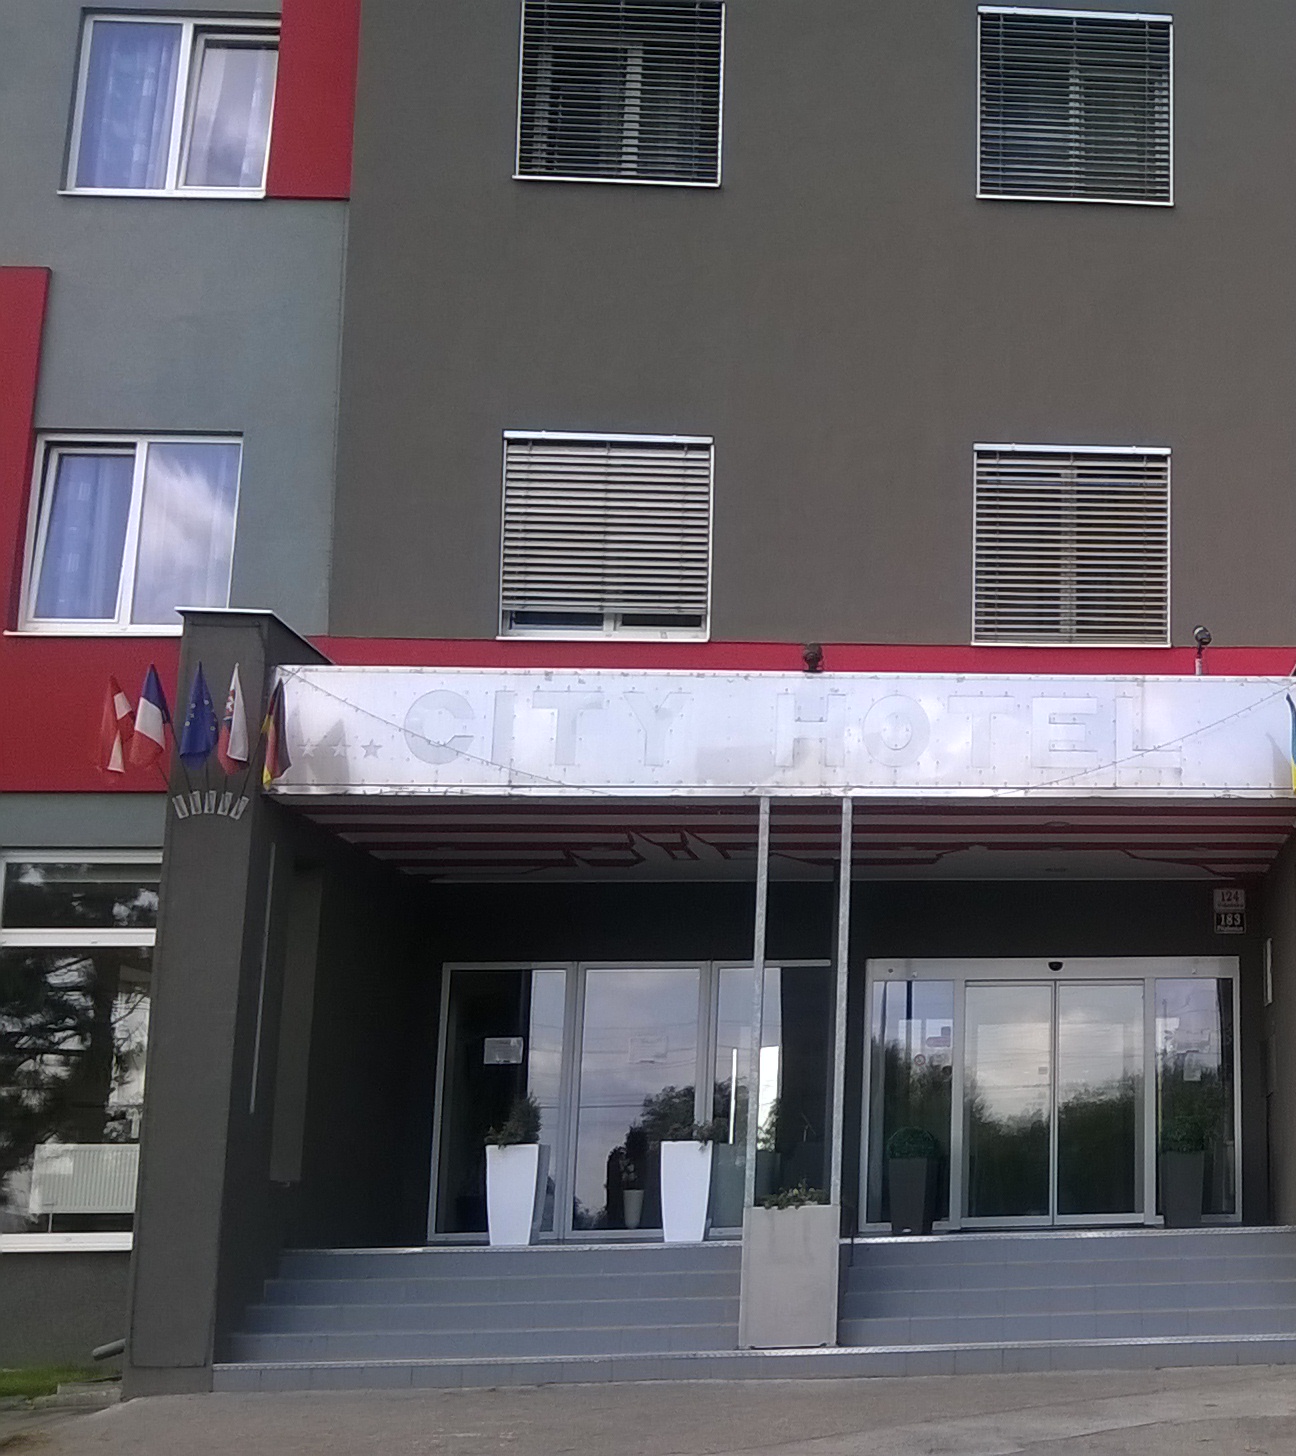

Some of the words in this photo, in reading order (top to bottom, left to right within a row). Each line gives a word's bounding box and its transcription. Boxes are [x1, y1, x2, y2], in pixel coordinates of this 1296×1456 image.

[403, 689, 692, 767] CITY
[775, 693, 1183, 769] HOTEL
[1221, 890, 1240, 902] 124
